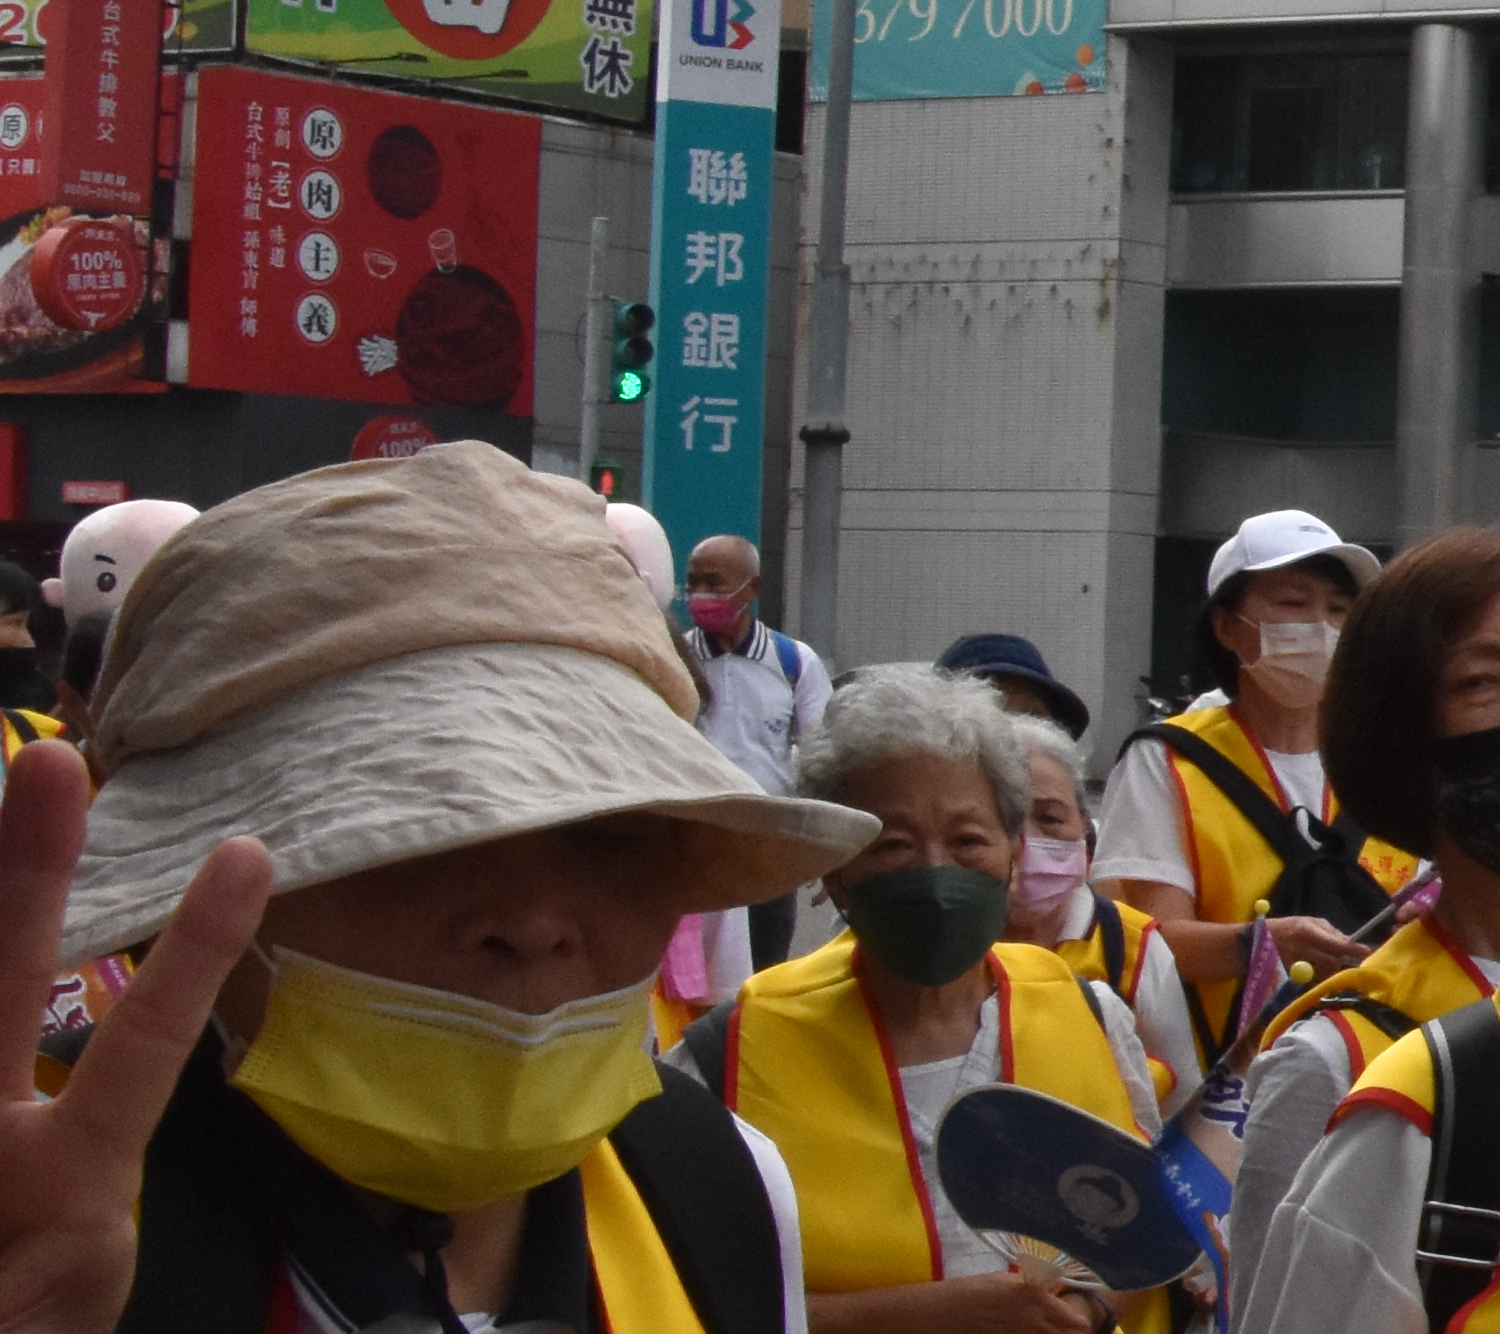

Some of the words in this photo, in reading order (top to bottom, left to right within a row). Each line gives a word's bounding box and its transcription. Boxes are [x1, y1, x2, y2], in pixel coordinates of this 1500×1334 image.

[678, 53, 724, 69] UNION
[725, 57, 764, 73] BANK
[70, 250, 123, 272] 100%
[304, 117, 337, 339] 原肉主義
[679, 146, 748, 455] 聯邦銀行
